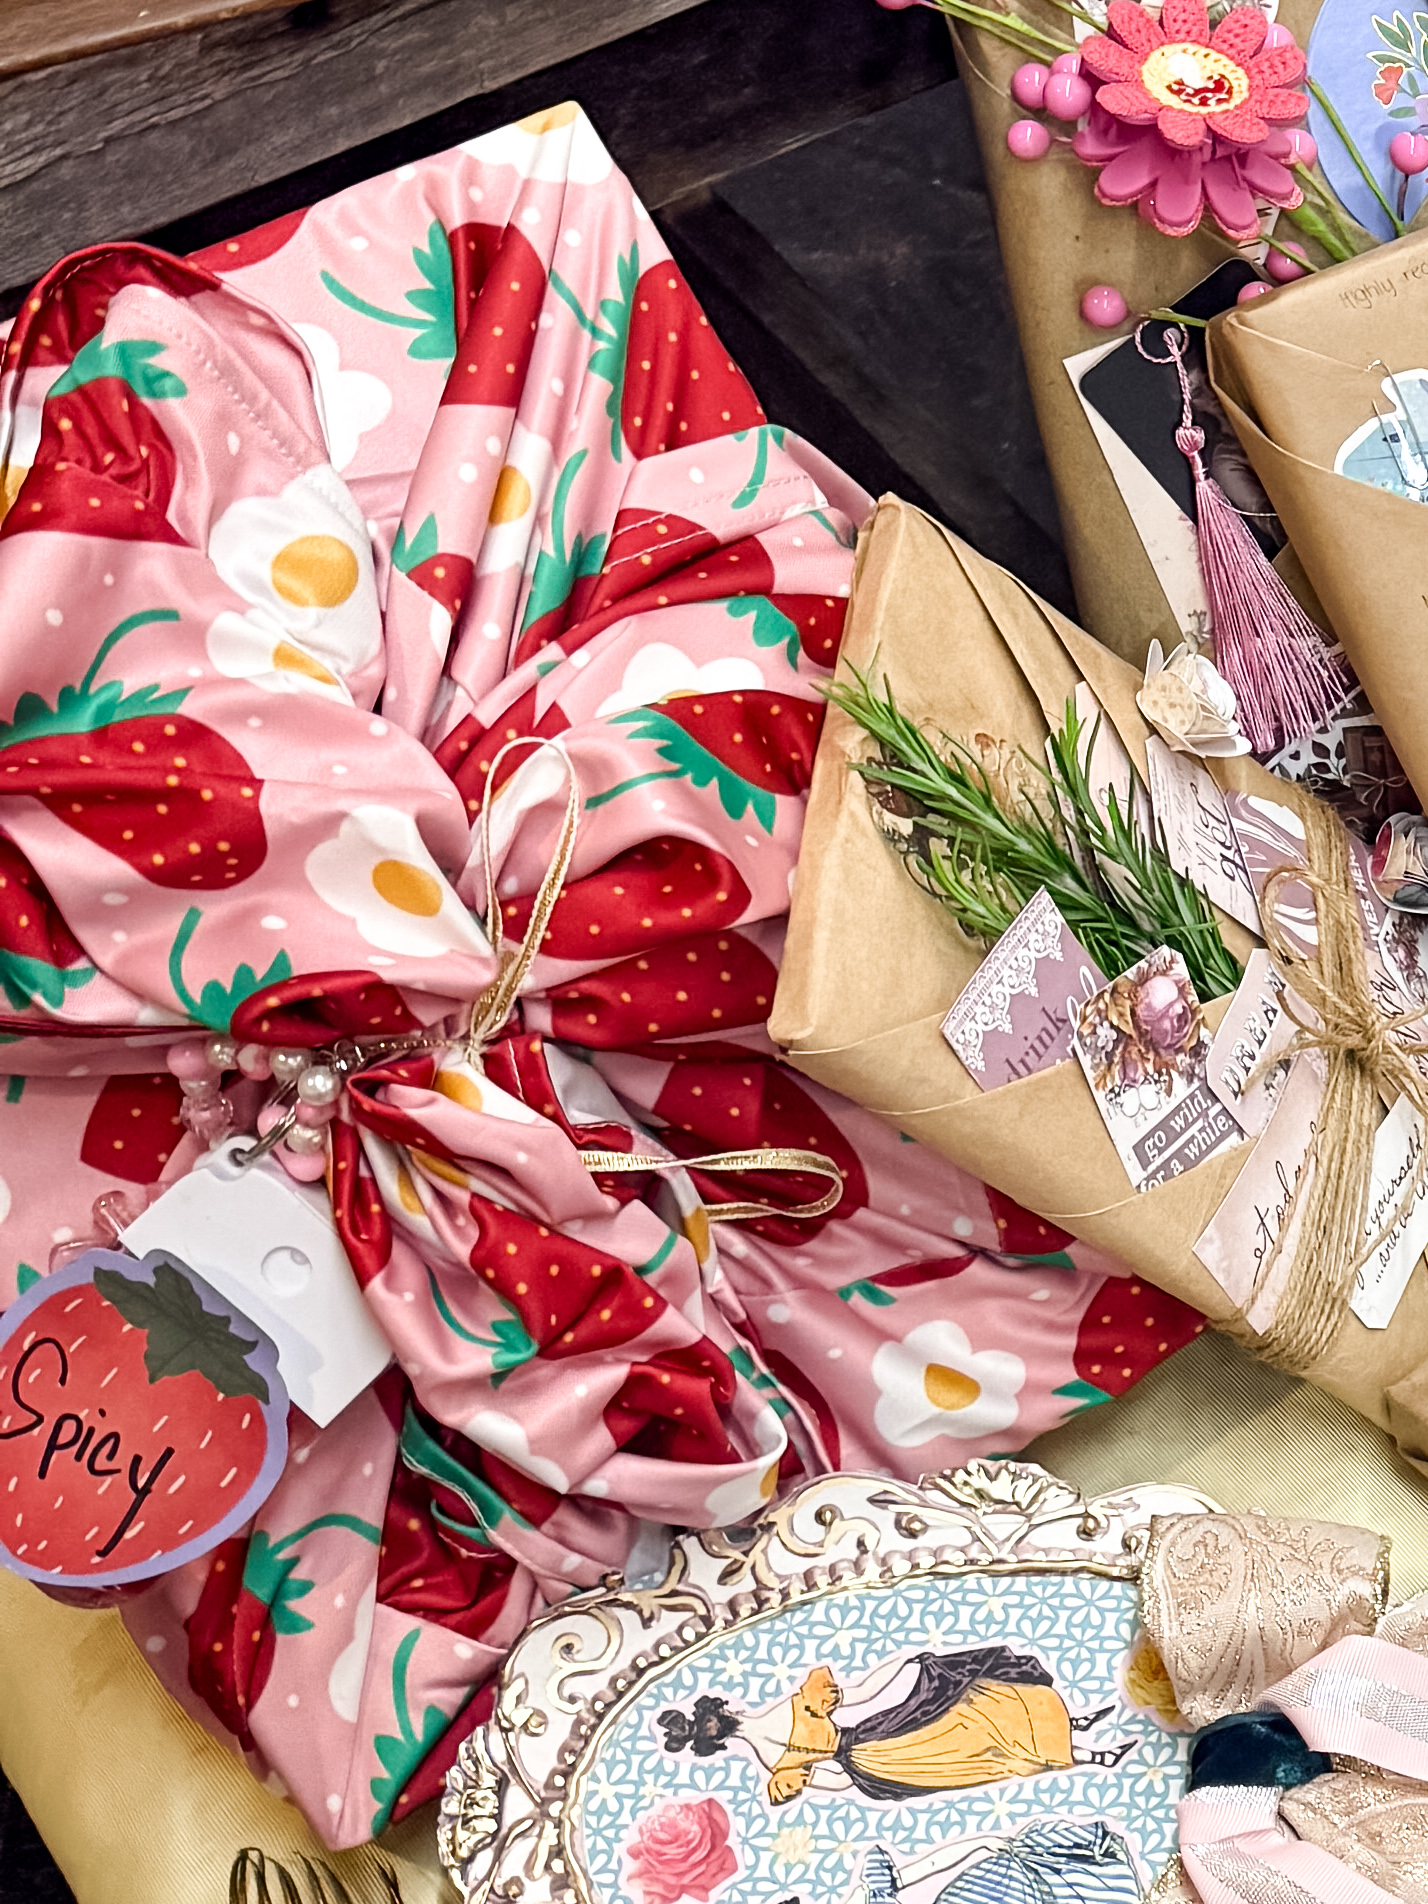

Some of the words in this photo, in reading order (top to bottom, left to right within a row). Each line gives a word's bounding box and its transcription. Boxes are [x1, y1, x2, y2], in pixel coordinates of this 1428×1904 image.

[1339, 276, 1398, 310] Highly
[1004, 1003, 1069, 1081] drink
[1143, 1130, 1167, 1164] go
[1170, 1091, 1213, 1134] wild,
[1170, 1160, 1184, 1176] a
[1186, 1114, 1233, 1163] while.
[0, 1337, 175, 1559] Spicy
